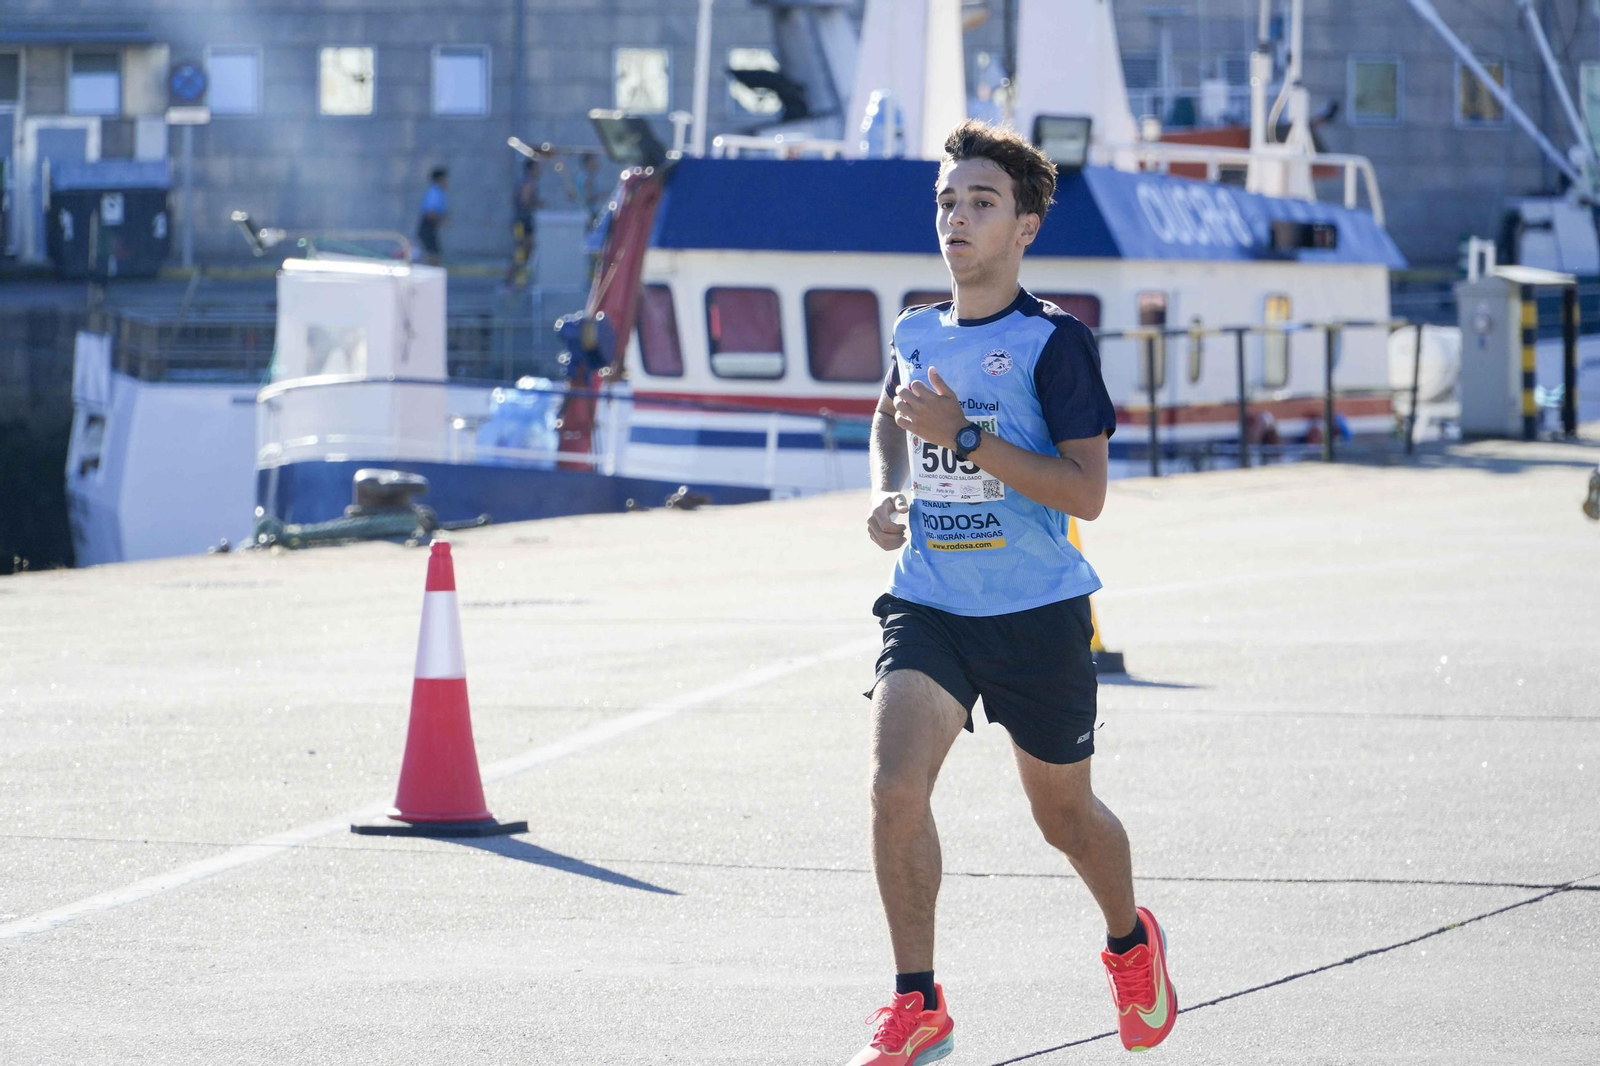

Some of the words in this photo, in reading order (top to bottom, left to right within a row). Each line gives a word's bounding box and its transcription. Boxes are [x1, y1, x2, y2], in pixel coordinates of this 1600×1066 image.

[968, 398, 999, 411] Duval
[922, 500, 952, 508] RENAULT
[922, 512, 1001, 531] RODOSA
[937, 532, 965, 540] NIGRÁN
[970, 530, 1003, 539] CANGAS
[932, 542, 992, 550] www.rodosa.com
